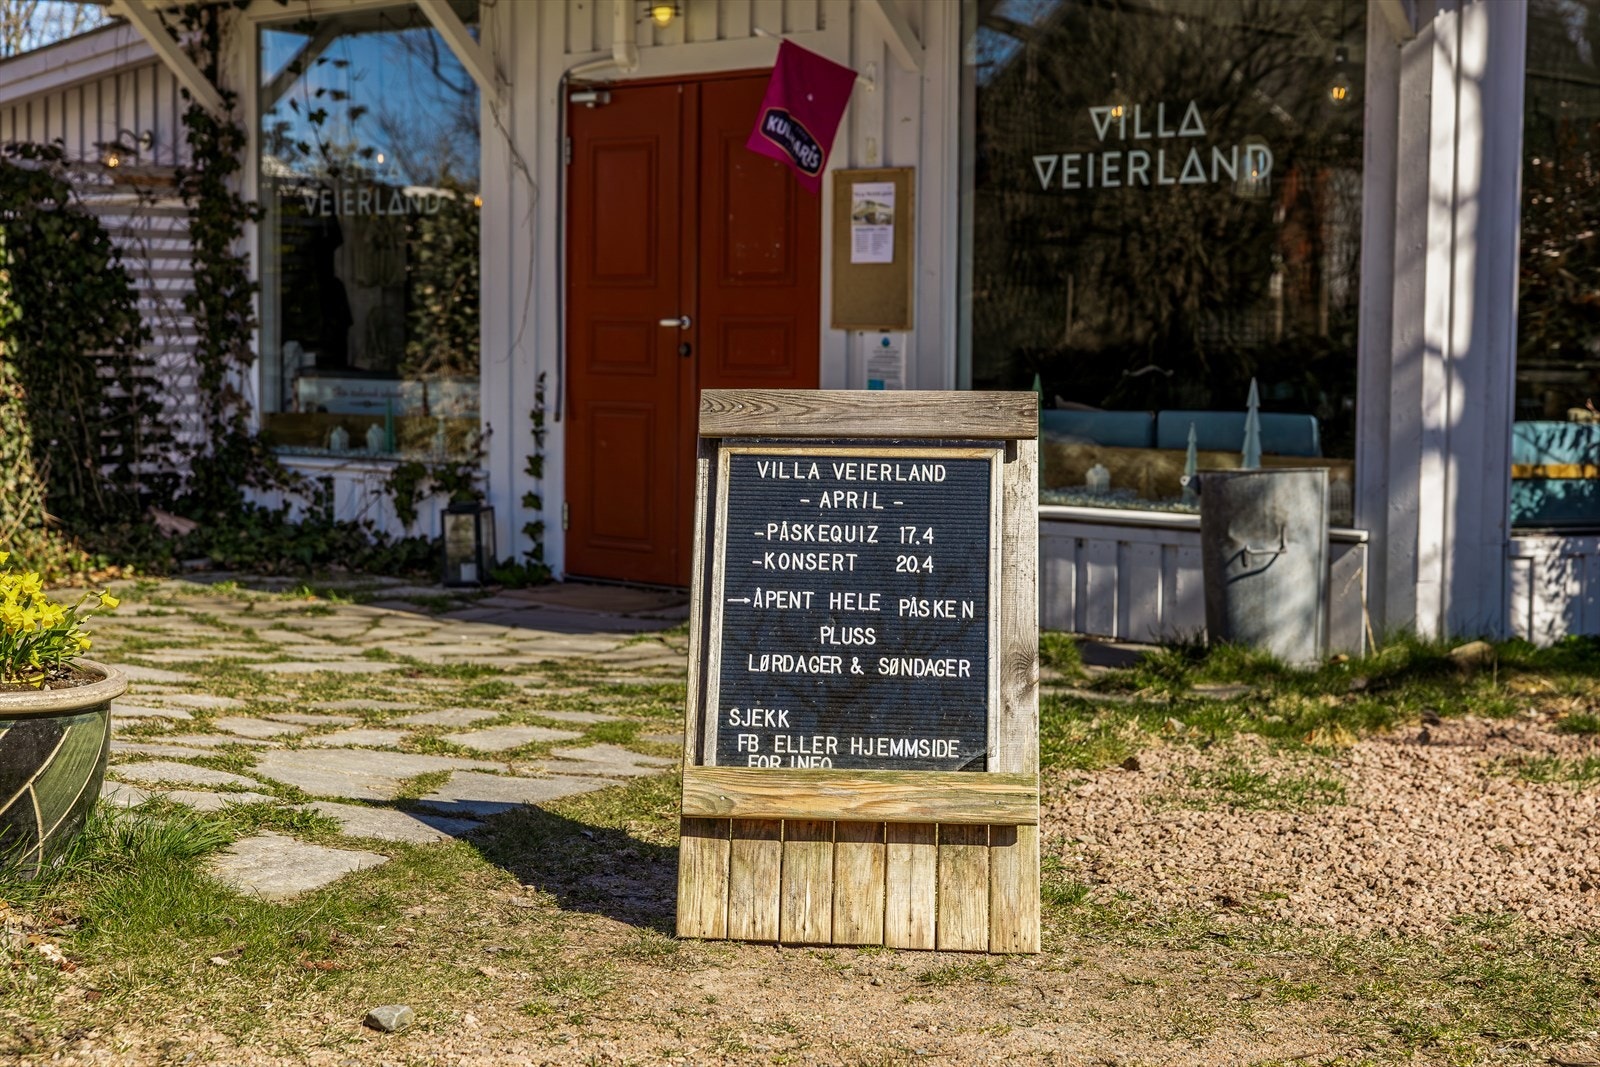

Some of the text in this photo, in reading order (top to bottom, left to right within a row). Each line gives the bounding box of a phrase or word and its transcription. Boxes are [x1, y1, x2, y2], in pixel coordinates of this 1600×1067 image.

[1088, 100, 1207, 142] VILLA
[1032, 144, 1274, 191] VEIERLAND
[303, 186, 442, 217] VEIERLAND
[757, 461, 946, 483] VILLA VEIERLAND
[819, 491, 884, 510] APRIL
[899, 526, 935, 546] 17.4
[895, 555, 935, 574] 20.4
[753, 586, 975, 619] ÅPENT HELE PÅSKEN
[820, 626, 876, 646] PLUSS
[748, 653, 971, 678] LØRDAGER & SØNDAGER
[728, 708, 790, 729] SJEKK
[737, 734, 960, 759] FB ELLER HJEMMSIDE
[748, 755, 833, 768] FOR INFO
